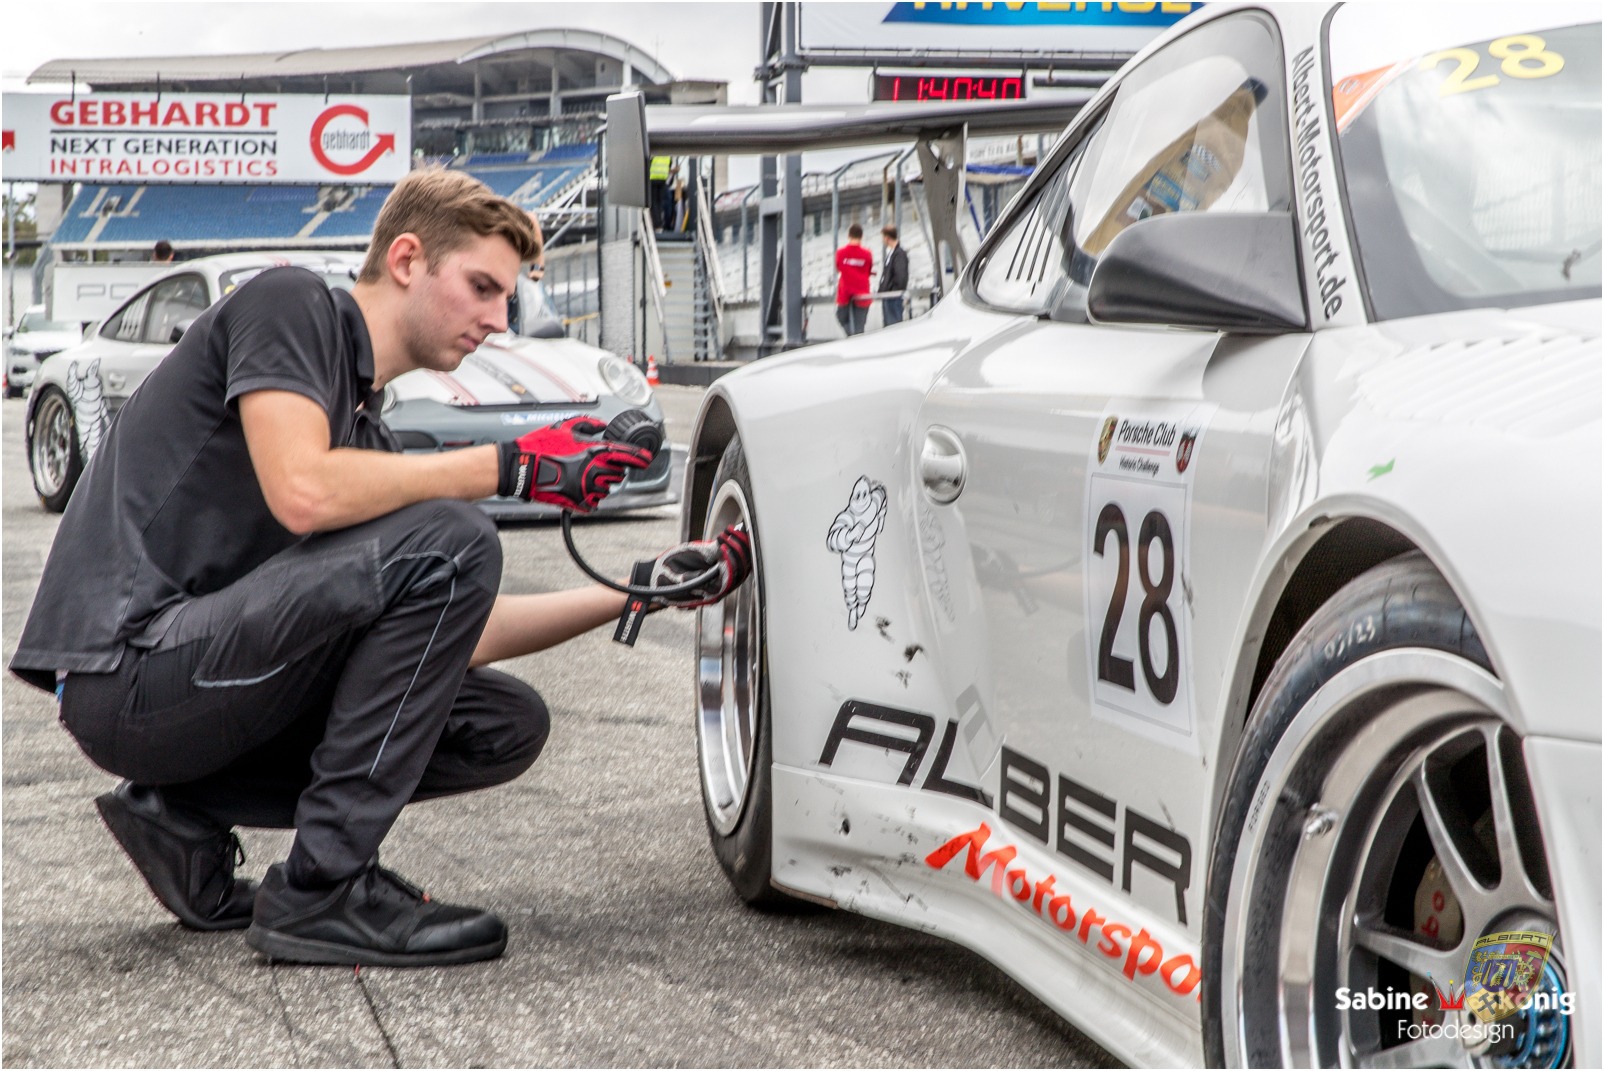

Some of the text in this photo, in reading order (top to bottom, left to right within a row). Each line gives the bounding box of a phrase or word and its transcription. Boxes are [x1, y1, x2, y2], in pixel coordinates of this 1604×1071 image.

[1418, 34, 1565, 98] 28
[893, 77, 1022, 102] 11:40:40
[50, 99, 278, 128] GEBHARDT
[50, 137, 278, 156] NEXT GENERATION
[322, 129, 370, 151] gebhardt
[50, 158, 278, 177] INTRALOGISTICS
[1291, 45, 1347, 321] Albert-Motorsport.de
[1117, 419, 1177, 448] Porsche Club
[1093, 502, 1180, 705] 28
[924, 822, 1202, 1004] Motorspo
